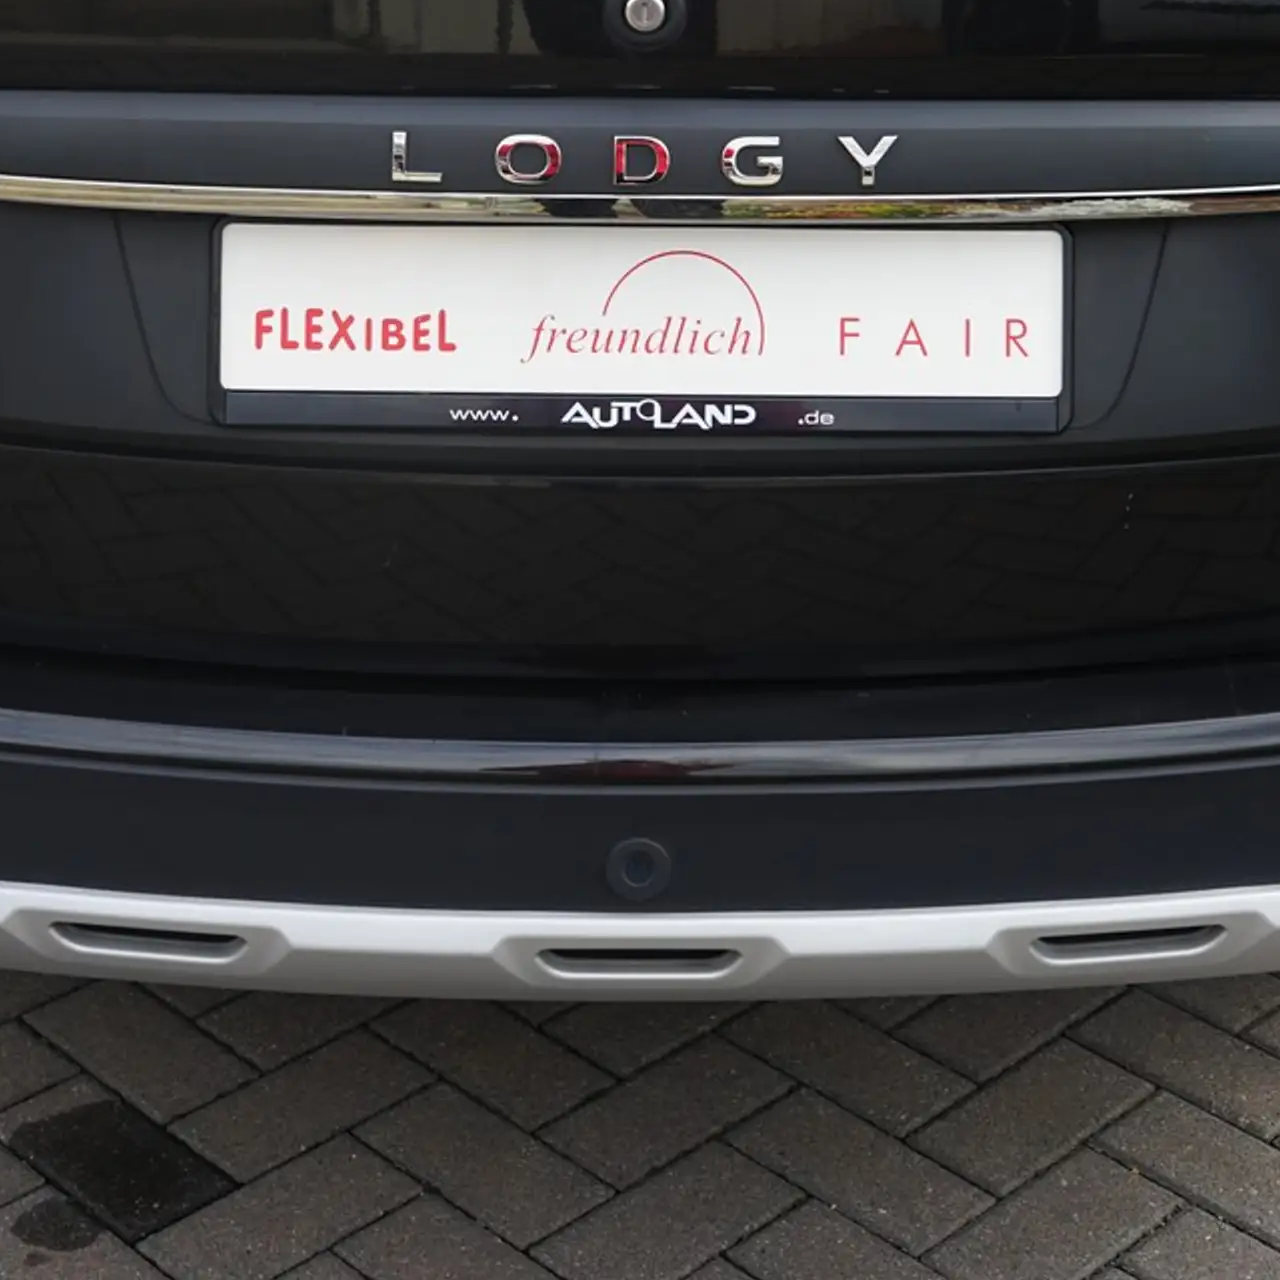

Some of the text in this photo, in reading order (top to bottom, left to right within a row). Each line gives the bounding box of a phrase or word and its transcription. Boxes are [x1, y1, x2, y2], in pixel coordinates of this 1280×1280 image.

[391, 130, 899, 186] LODGY
[253, 306, 1030, 364] FLEXIBEL freundlich FAIR
[448, 397, 835, 430] www. AUTOLAND .de
